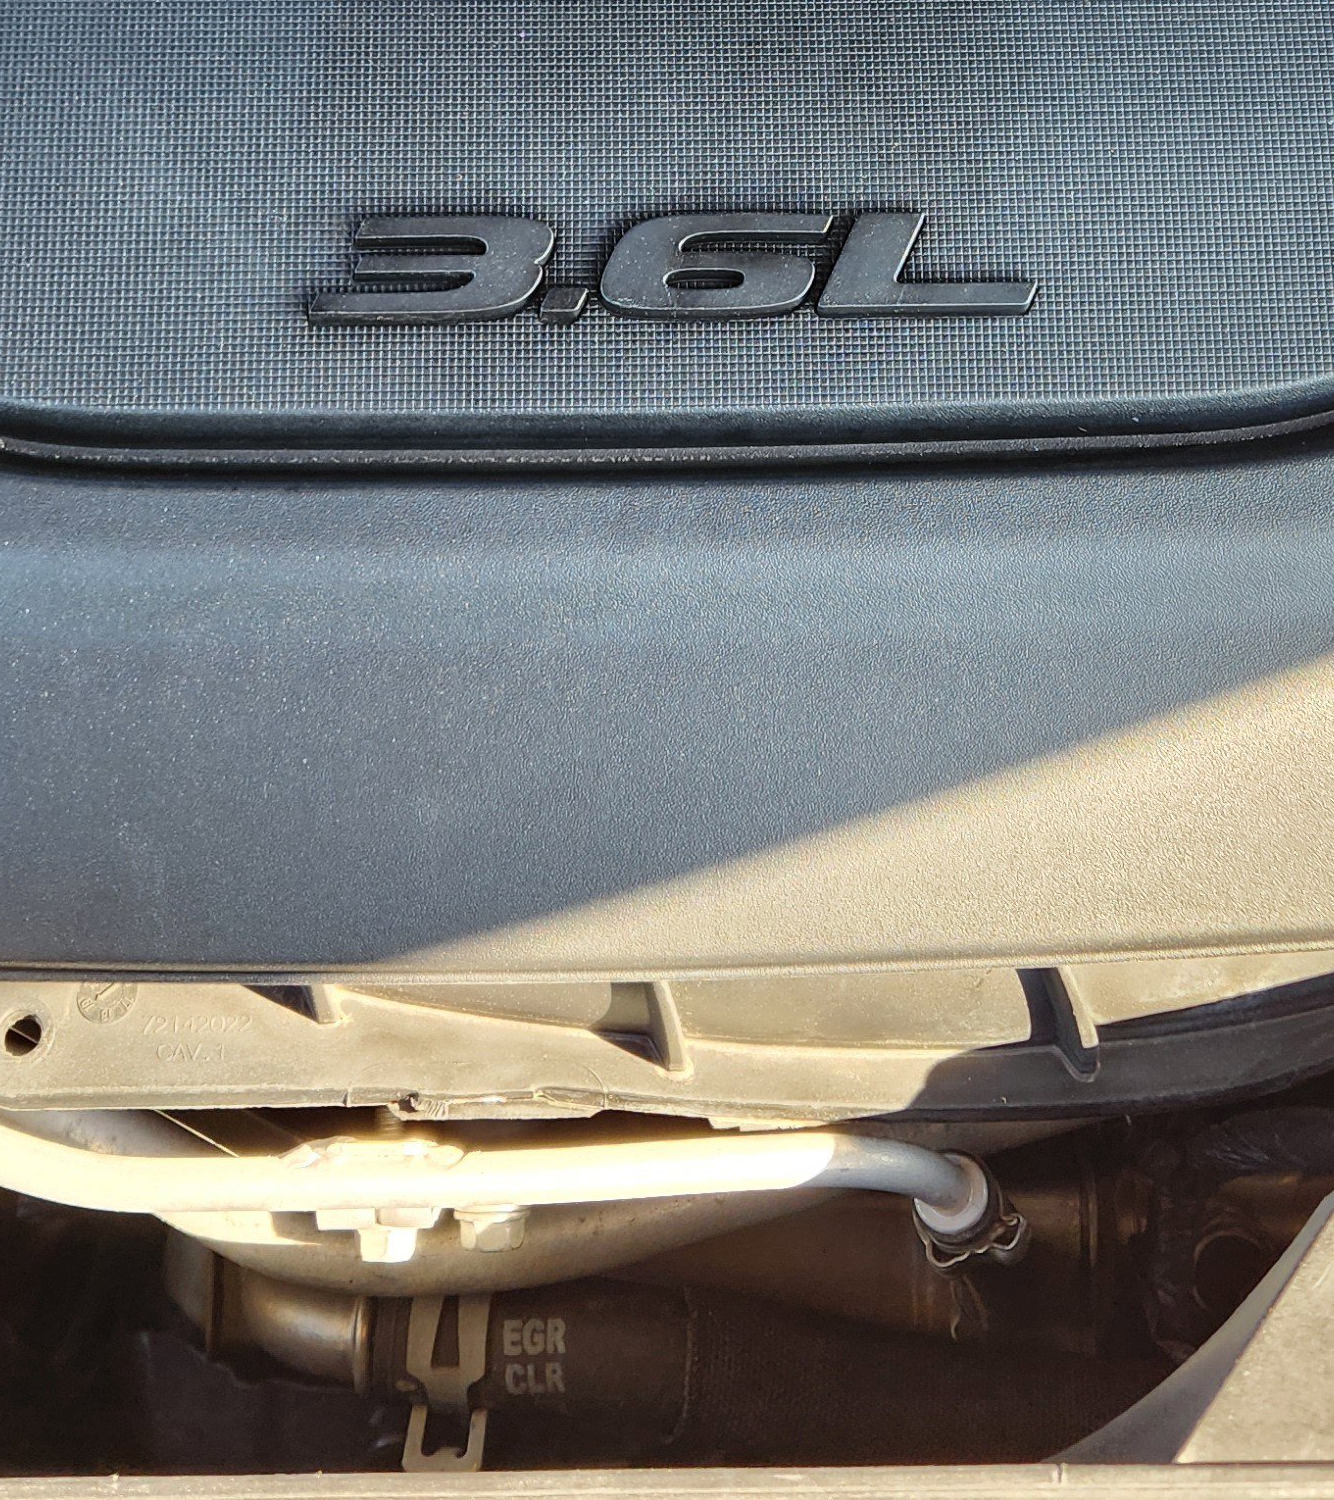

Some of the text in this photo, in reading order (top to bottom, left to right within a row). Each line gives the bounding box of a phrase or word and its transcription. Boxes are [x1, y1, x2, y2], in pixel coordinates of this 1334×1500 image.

[307, 209, 1040, 327] 3.6L
[503, 1317, 567, 1356] EGR
[505, 1361, 567, 1395] CLR
